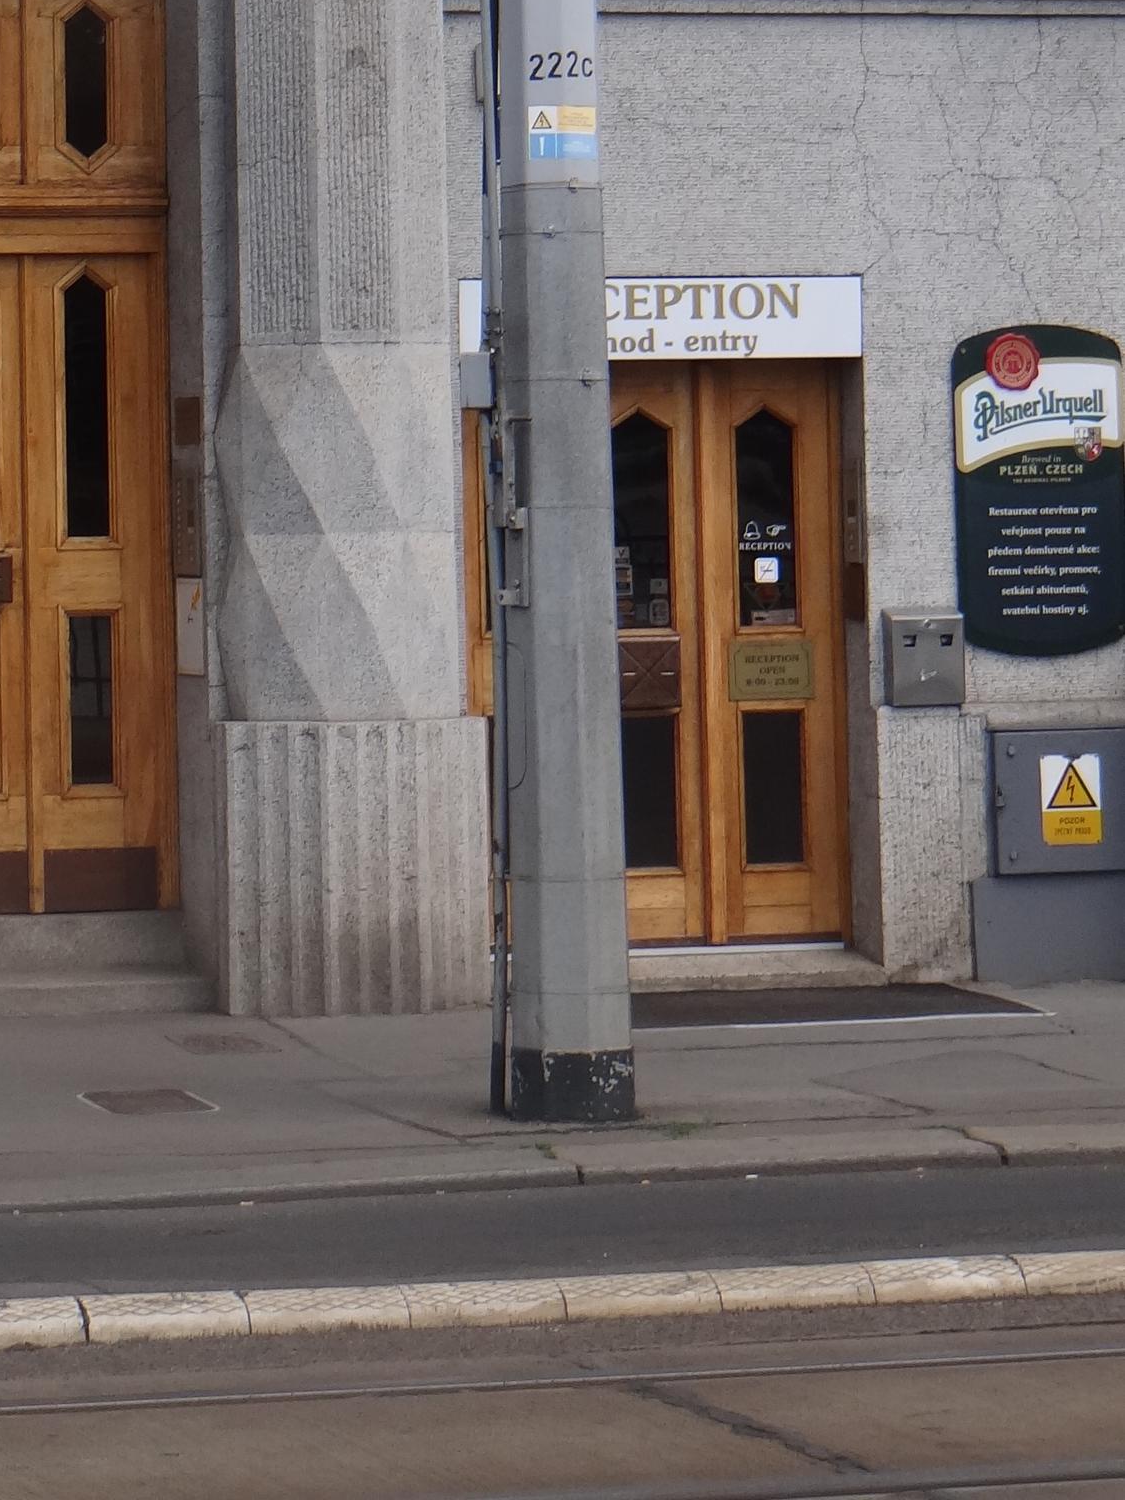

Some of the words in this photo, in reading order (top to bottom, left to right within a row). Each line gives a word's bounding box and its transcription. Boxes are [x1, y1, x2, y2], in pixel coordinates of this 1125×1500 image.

[529, 51, 593, 80] 222c
[684, 330, 758, 357] entry
[973, 390, 1041, 442] Pilsner
[1039, 387, 1104, 425] Urquell
[1053, 454, 1062, 463] in
[1045, 464, 1084, 475] CZECH
[988, 507, 1037, 516] Restaurace
[1040, 505, 1079, 516] otevřena
[1081, 506, 1097, 516] pro
[1001, 526, 1042, 537] veřejnost
[1045, 527, 1072, 537] pouze
[1074, 526, 1086, 535] na
[739, 542, 792, 551] RECEPTION
[987, 546, 1022, 558] předem
[1024, 544, 1074, 555] domluvené
[1076, 544, 1100, 555] akce:
[988, 565, 1021, 576] firemní
[1059, 566, 1102, 576] promoce,
[1001, 586, 1034, 596] setkání
[1036, 584, 1089, 596] abiturientů,
[1002, 605, 1040, 616] svatební
[1042, 604, 1075, 616] hostiny
[1077, 604, 1089, 616] aj.
[745, 654, 799, 663] RECEPTION
[759, 666, 785, 675] OPEN
[1059, 816, 1085, 825] POZOR
